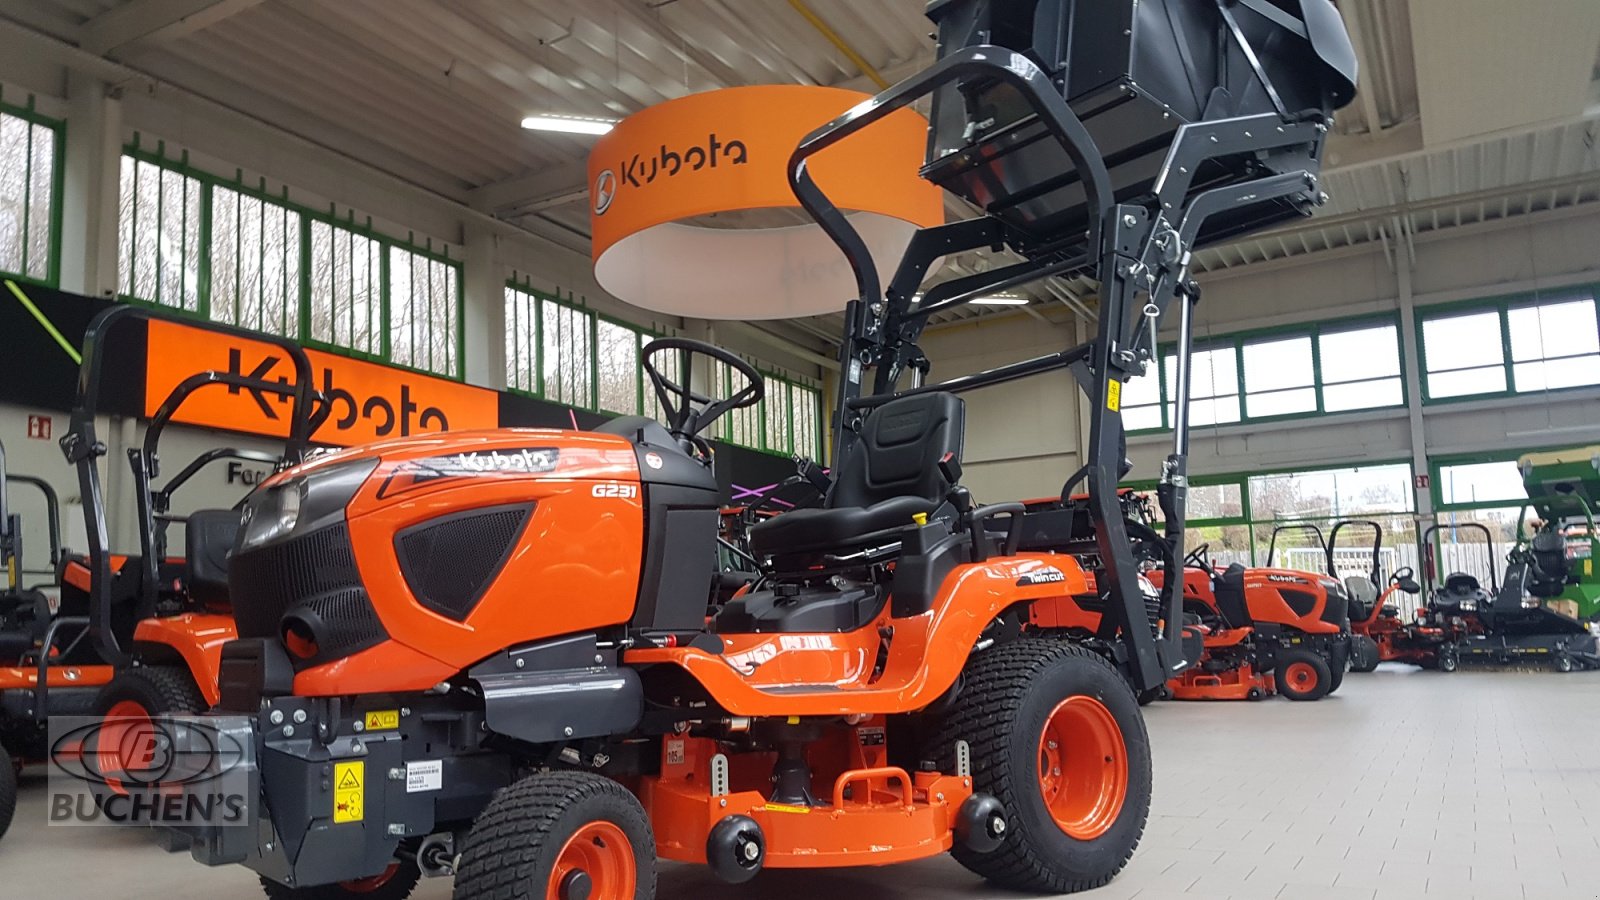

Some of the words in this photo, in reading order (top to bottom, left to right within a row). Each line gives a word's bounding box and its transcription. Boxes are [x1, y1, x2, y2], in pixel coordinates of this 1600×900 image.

[621, 133, 747, 187] Kubota
[459, 449, 549, 471] Kubota
[592, 484, 637, 498] G231
[1270, 574, 1296, 583] Kubota
